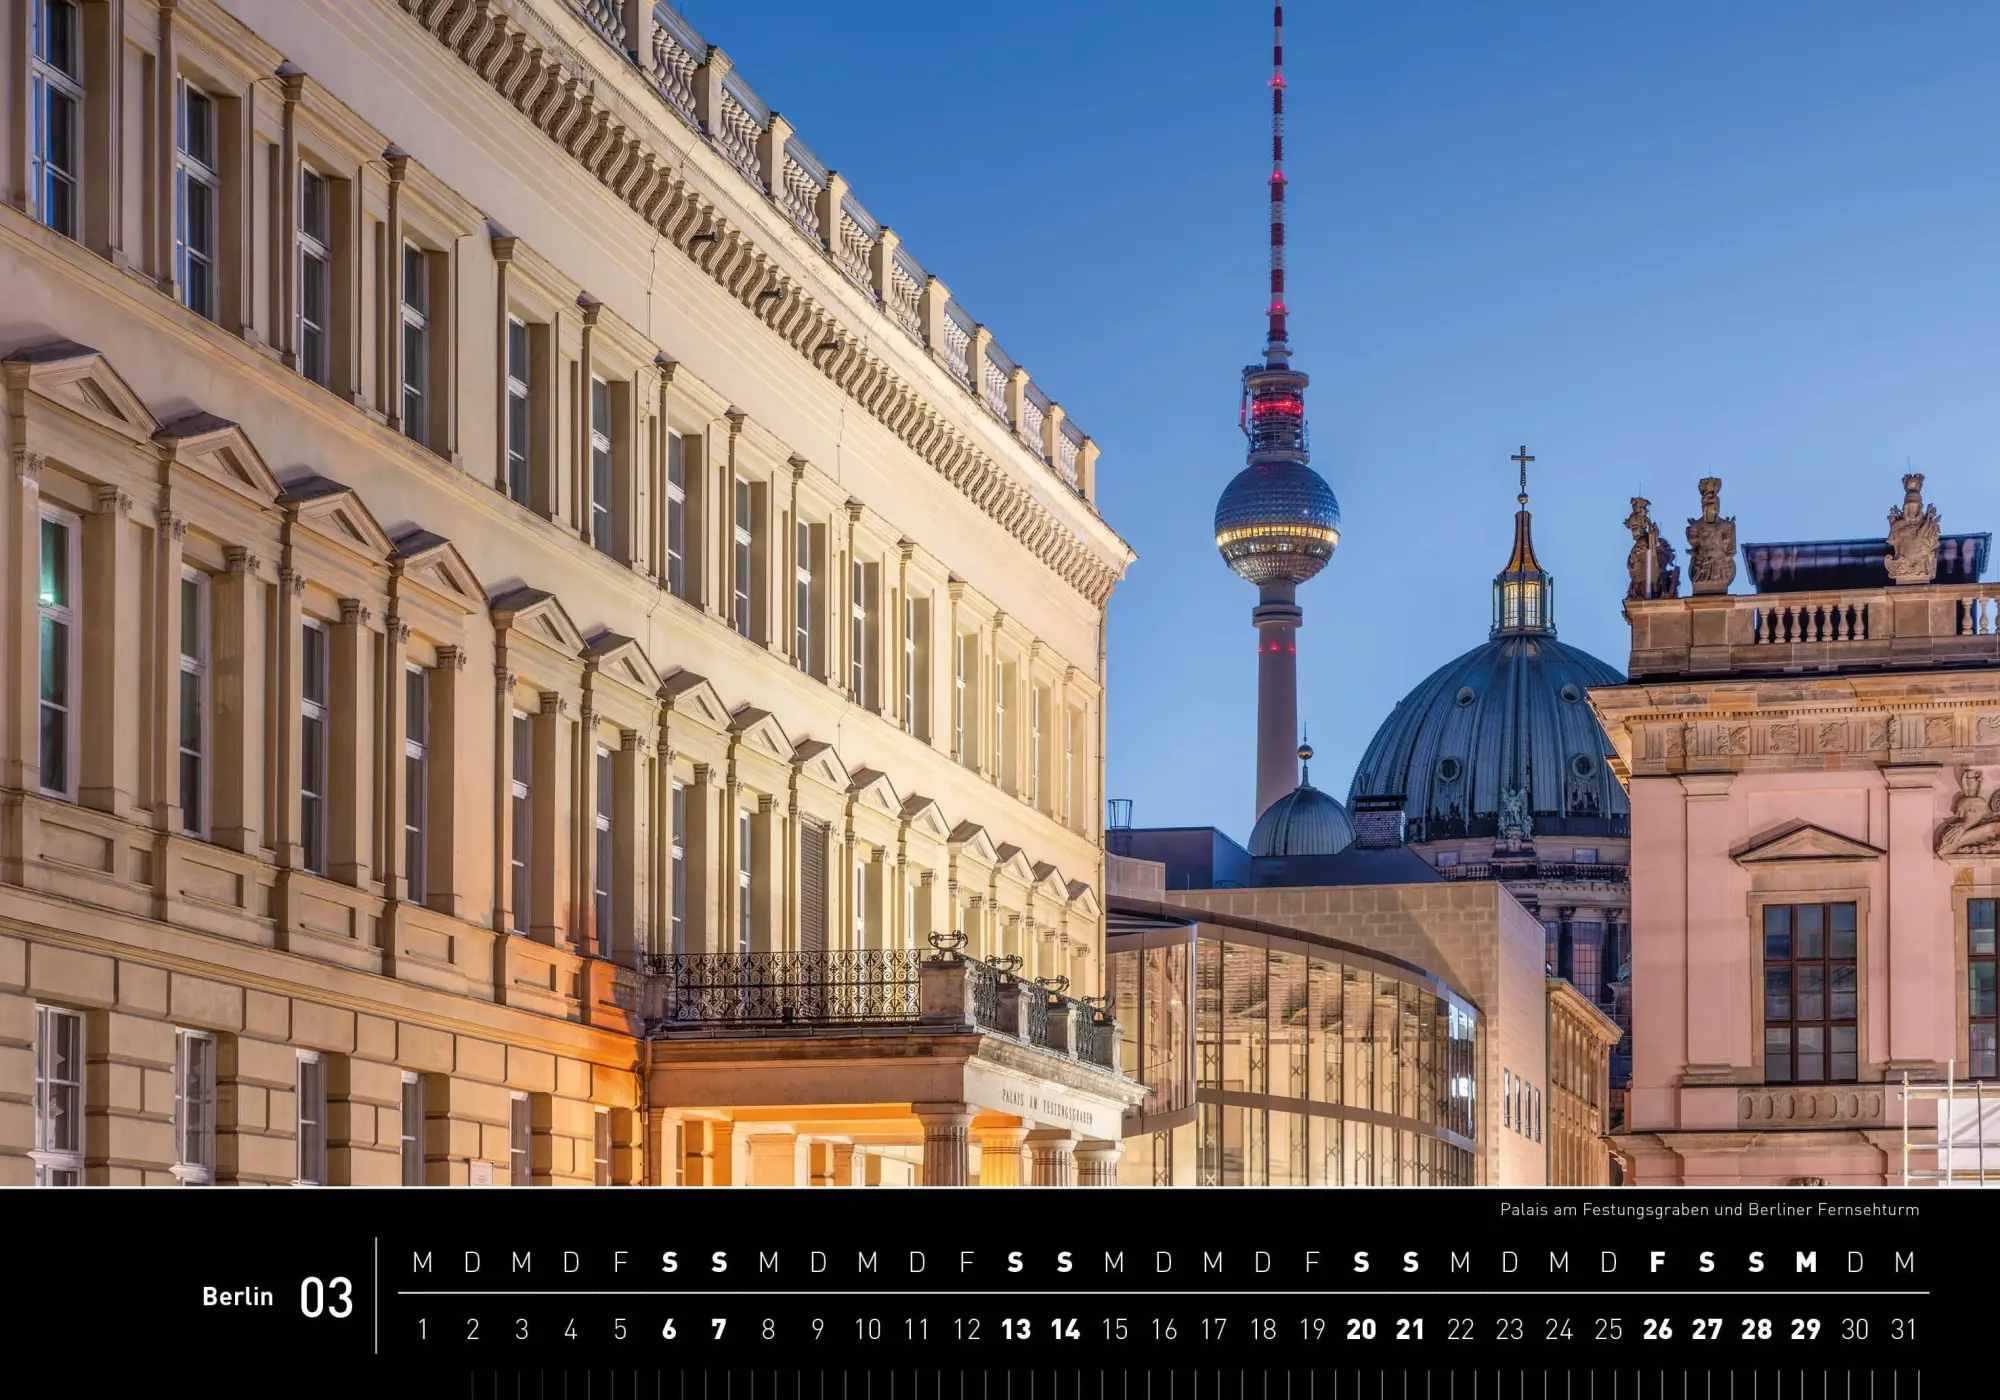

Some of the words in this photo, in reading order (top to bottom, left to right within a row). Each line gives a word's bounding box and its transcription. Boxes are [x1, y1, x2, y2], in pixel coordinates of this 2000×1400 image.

[1002, 1088, 1024, 1106] PALAIS
[1029, 1095, 1038, 1110] AM
[1043, 1100, 1093, 1125] FESTUNGSGRABEN
